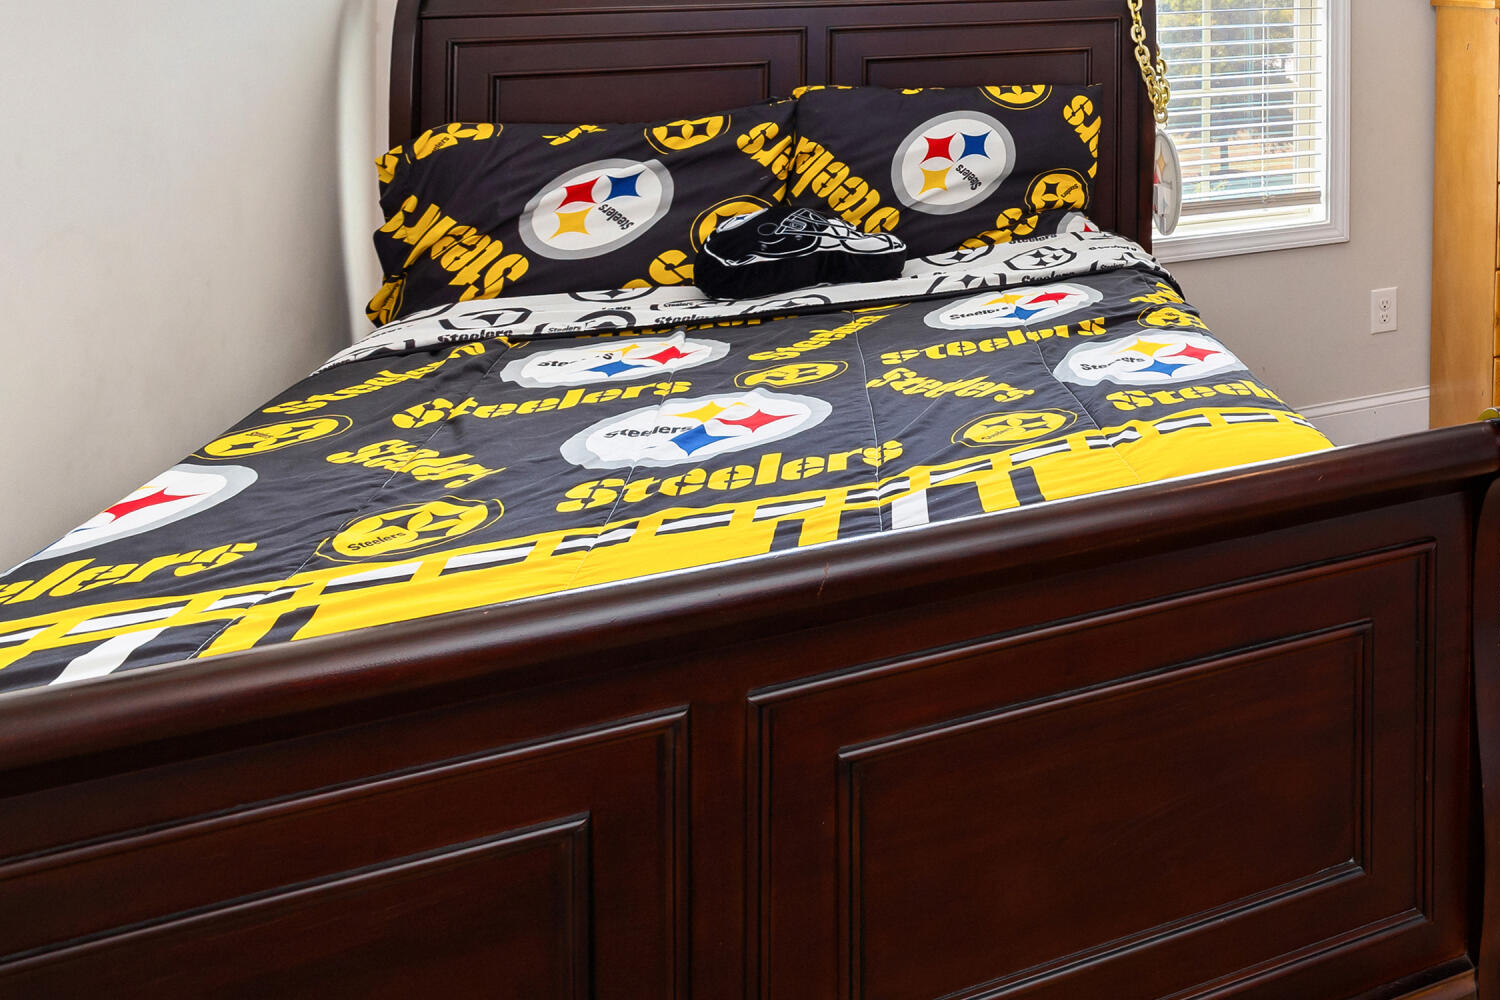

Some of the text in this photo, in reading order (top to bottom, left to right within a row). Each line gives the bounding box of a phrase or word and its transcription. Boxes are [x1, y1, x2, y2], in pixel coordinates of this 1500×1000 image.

[955, 164, 983, 191] Steelers
[598, 203, 635, 230] Steelers
[392, 381, 693, 429] Steelers
[556, 439, 904, 514] Steelers
[347, 530, 407, 551] Steelers
